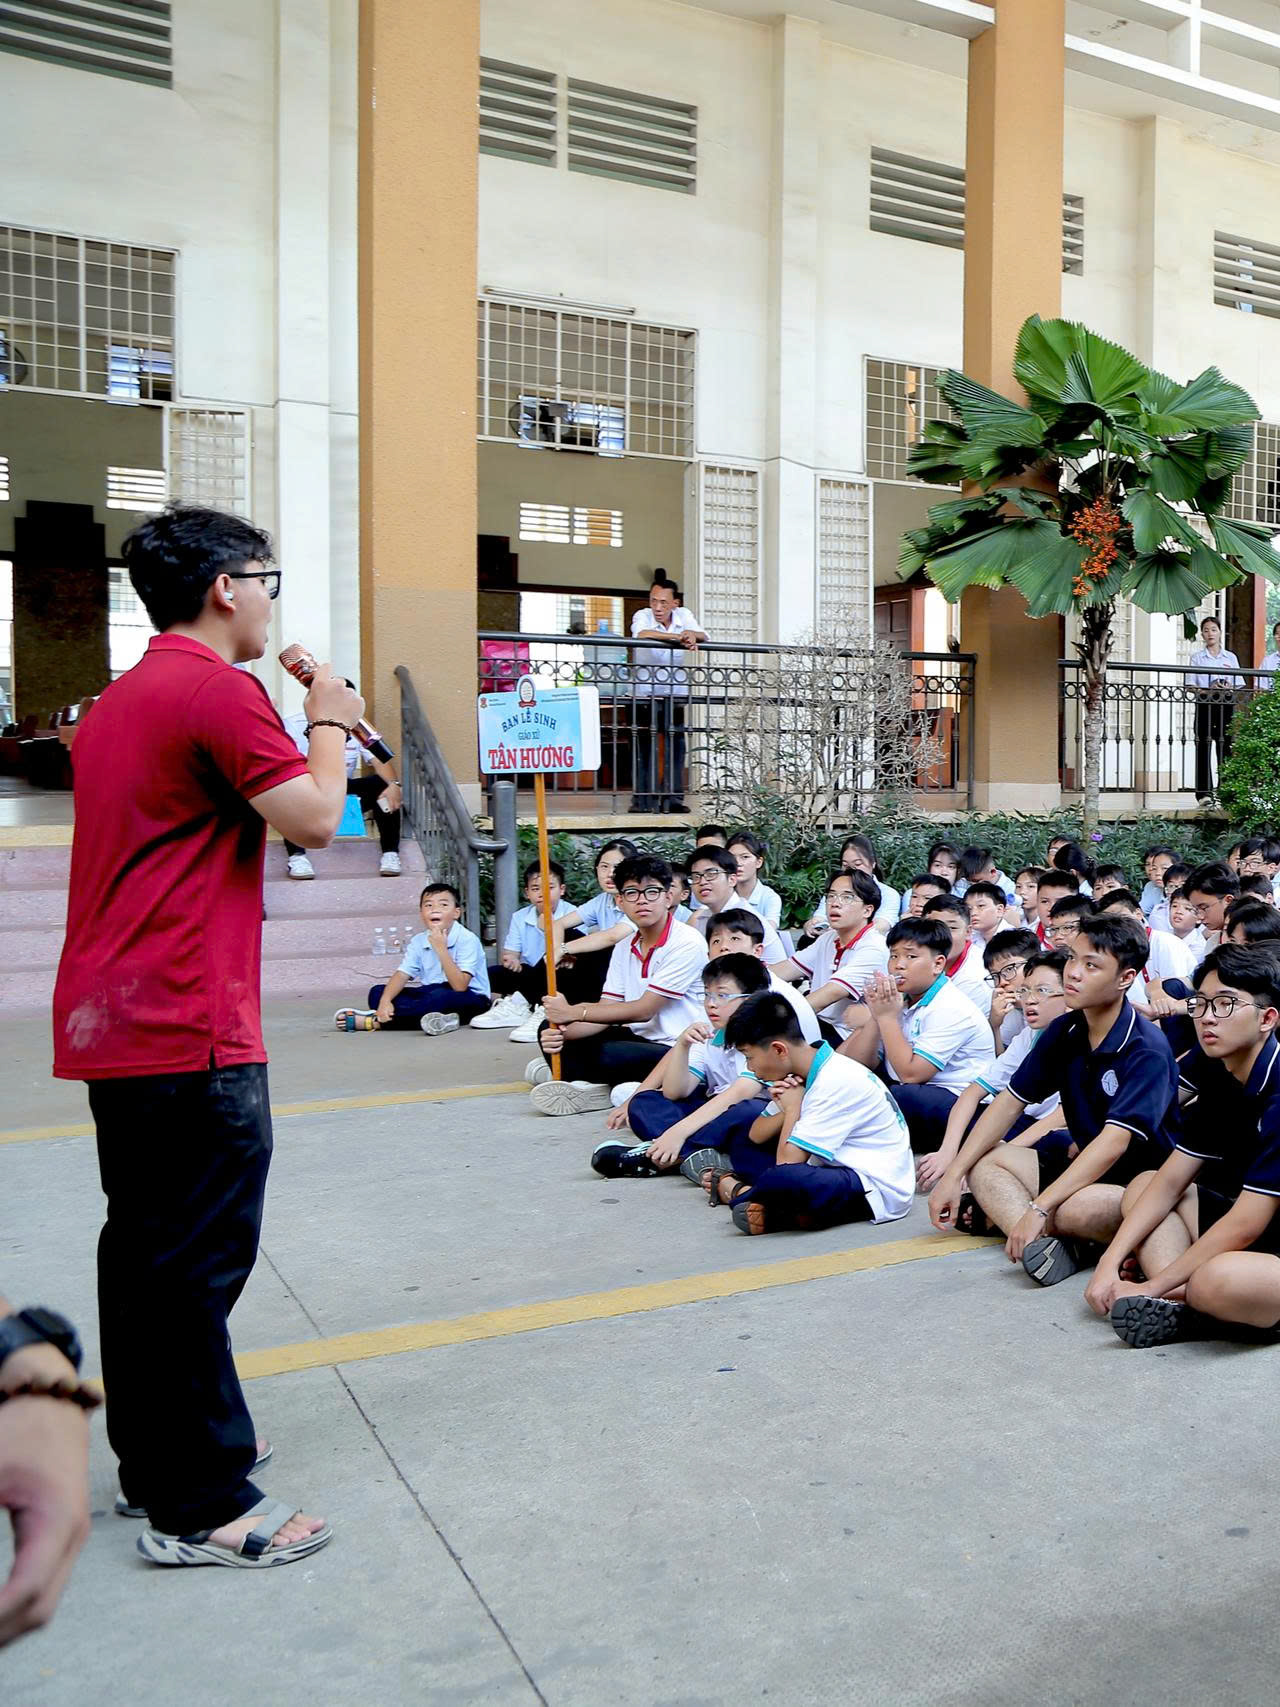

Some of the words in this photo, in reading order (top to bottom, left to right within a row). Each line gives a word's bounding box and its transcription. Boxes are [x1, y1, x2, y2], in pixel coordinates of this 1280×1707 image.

[501, 714, 519, 732] BAN
[534, 712, 557, 730] SINH
[488, 742, 518, 769] TÂN
[520, 744, 574, 769] HƯƠNG
